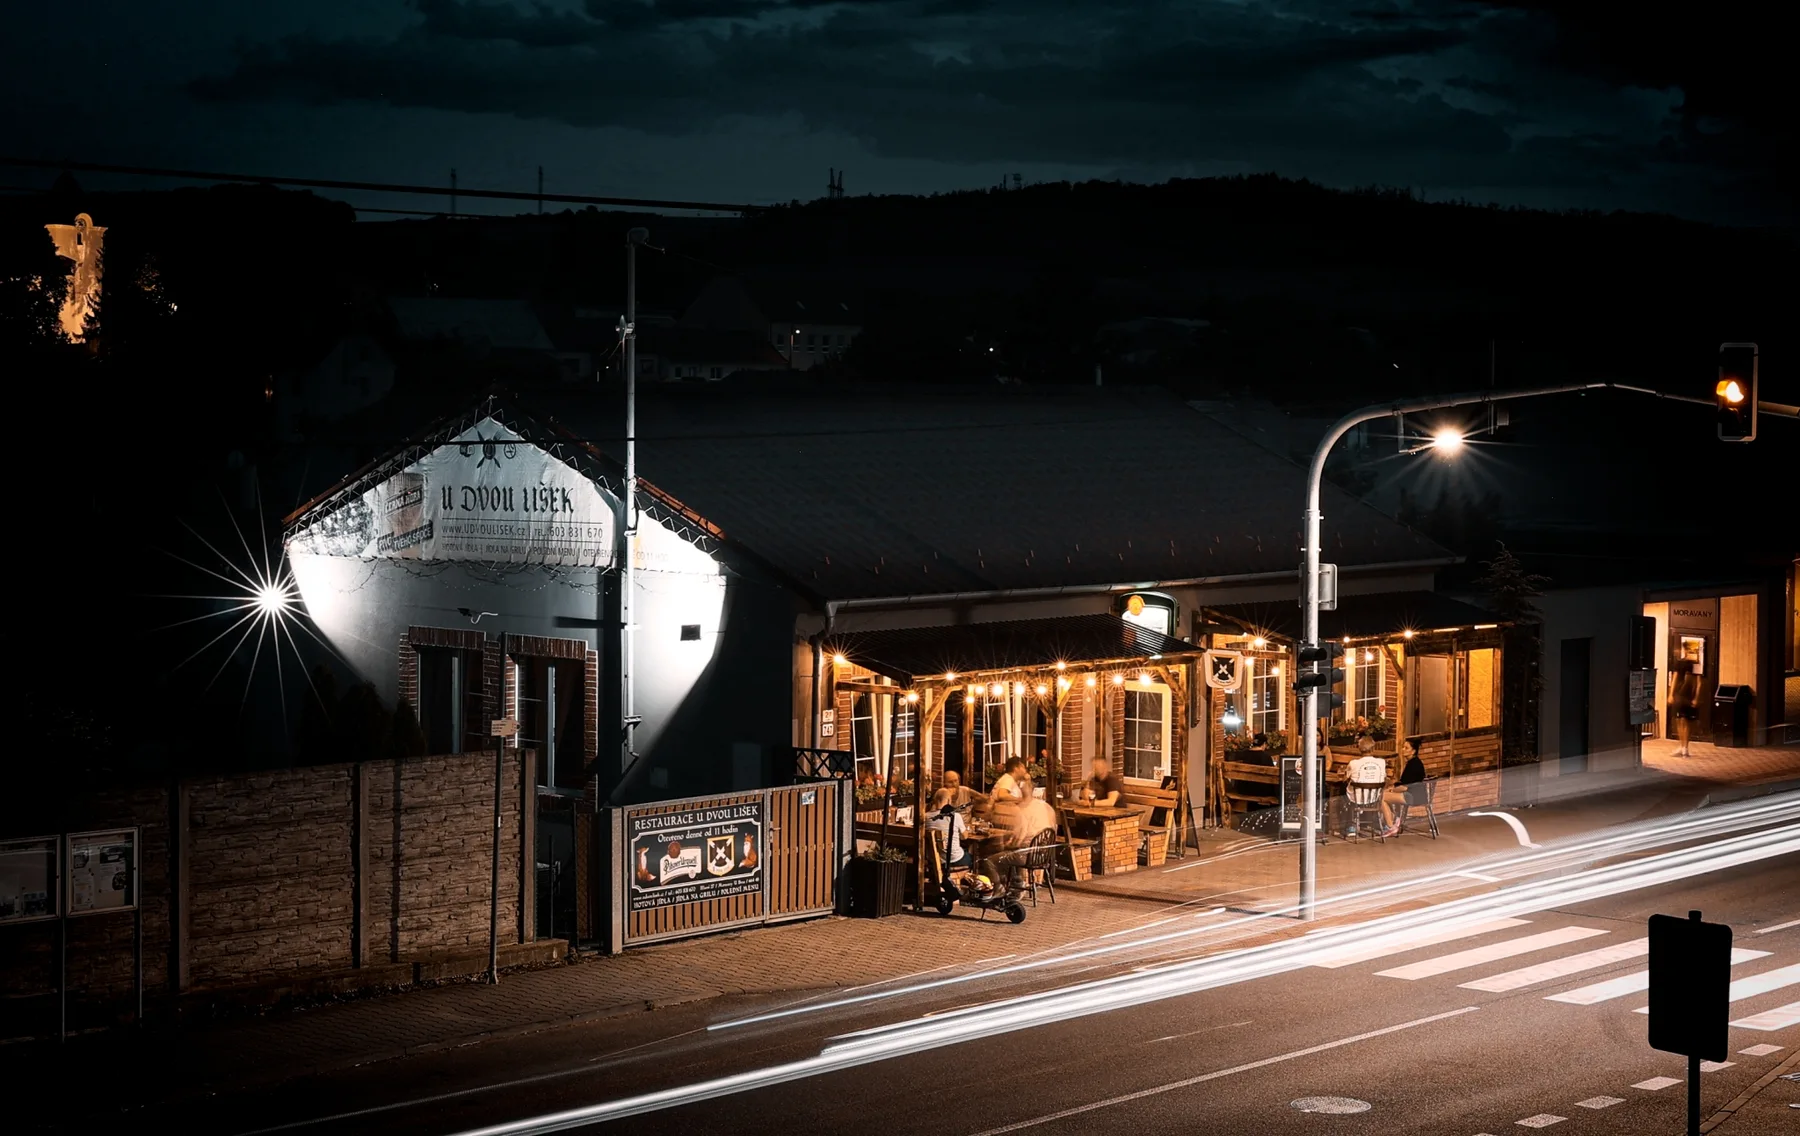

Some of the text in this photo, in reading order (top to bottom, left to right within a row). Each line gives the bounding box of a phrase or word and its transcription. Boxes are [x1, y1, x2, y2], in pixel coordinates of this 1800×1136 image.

[587, 527, 603, 539] 670
[1673, 609, 1713, 618] MORAVANY
[823, 725, 833, 735] 747
[635, 805, 758, 830] RESTAURACE U DVOU LIŠEK
